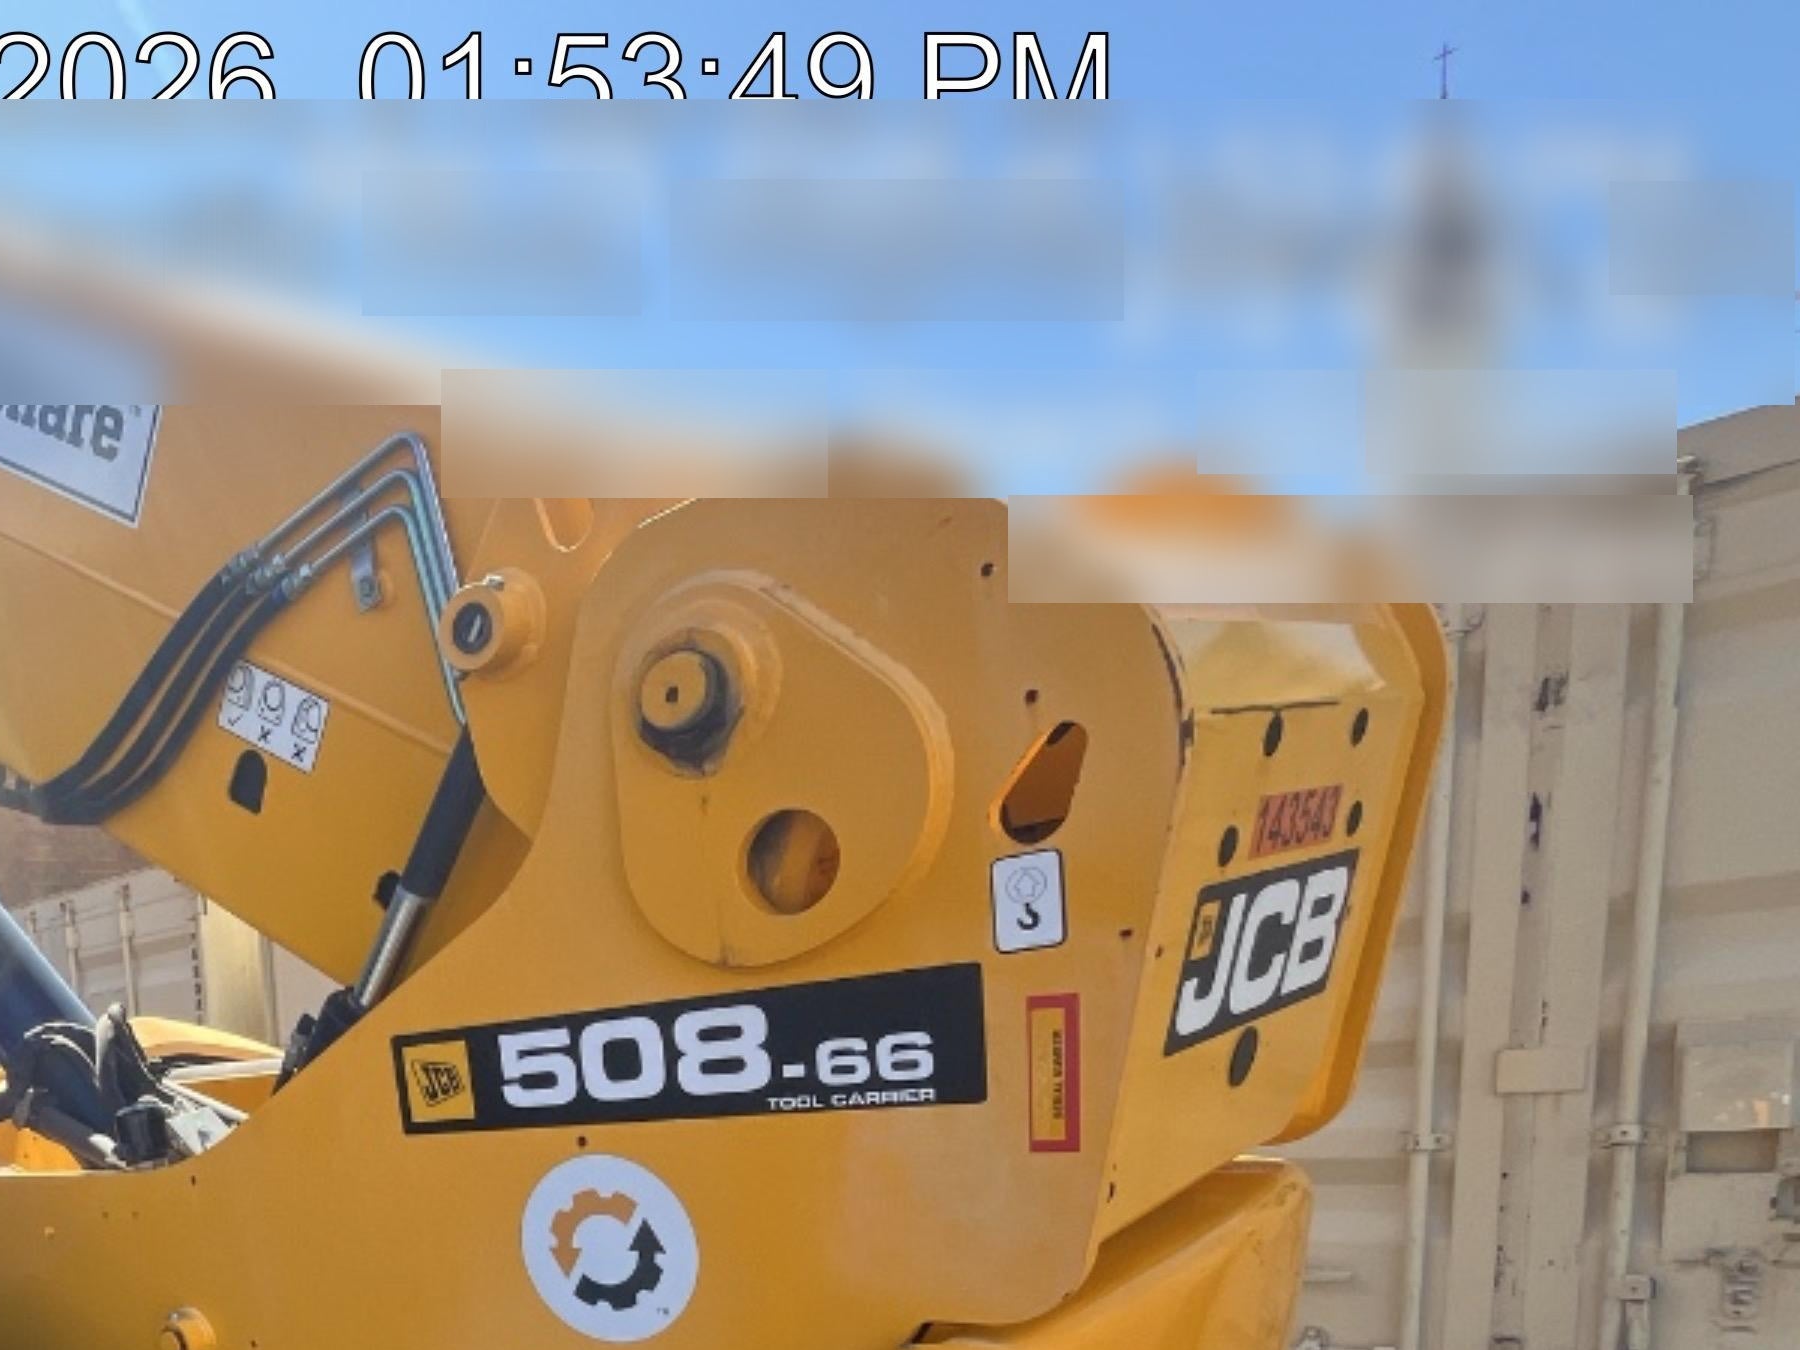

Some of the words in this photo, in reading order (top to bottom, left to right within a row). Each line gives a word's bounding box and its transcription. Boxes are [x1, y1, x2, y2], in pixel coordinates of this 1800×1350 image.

[1174, 866, 1349, 1038] JCB
[497, 1003, 936, 1109] 508-66
[767, 1094, 825, 1111] TOOL
[830, 1088, 937, 1107] CARRIER
